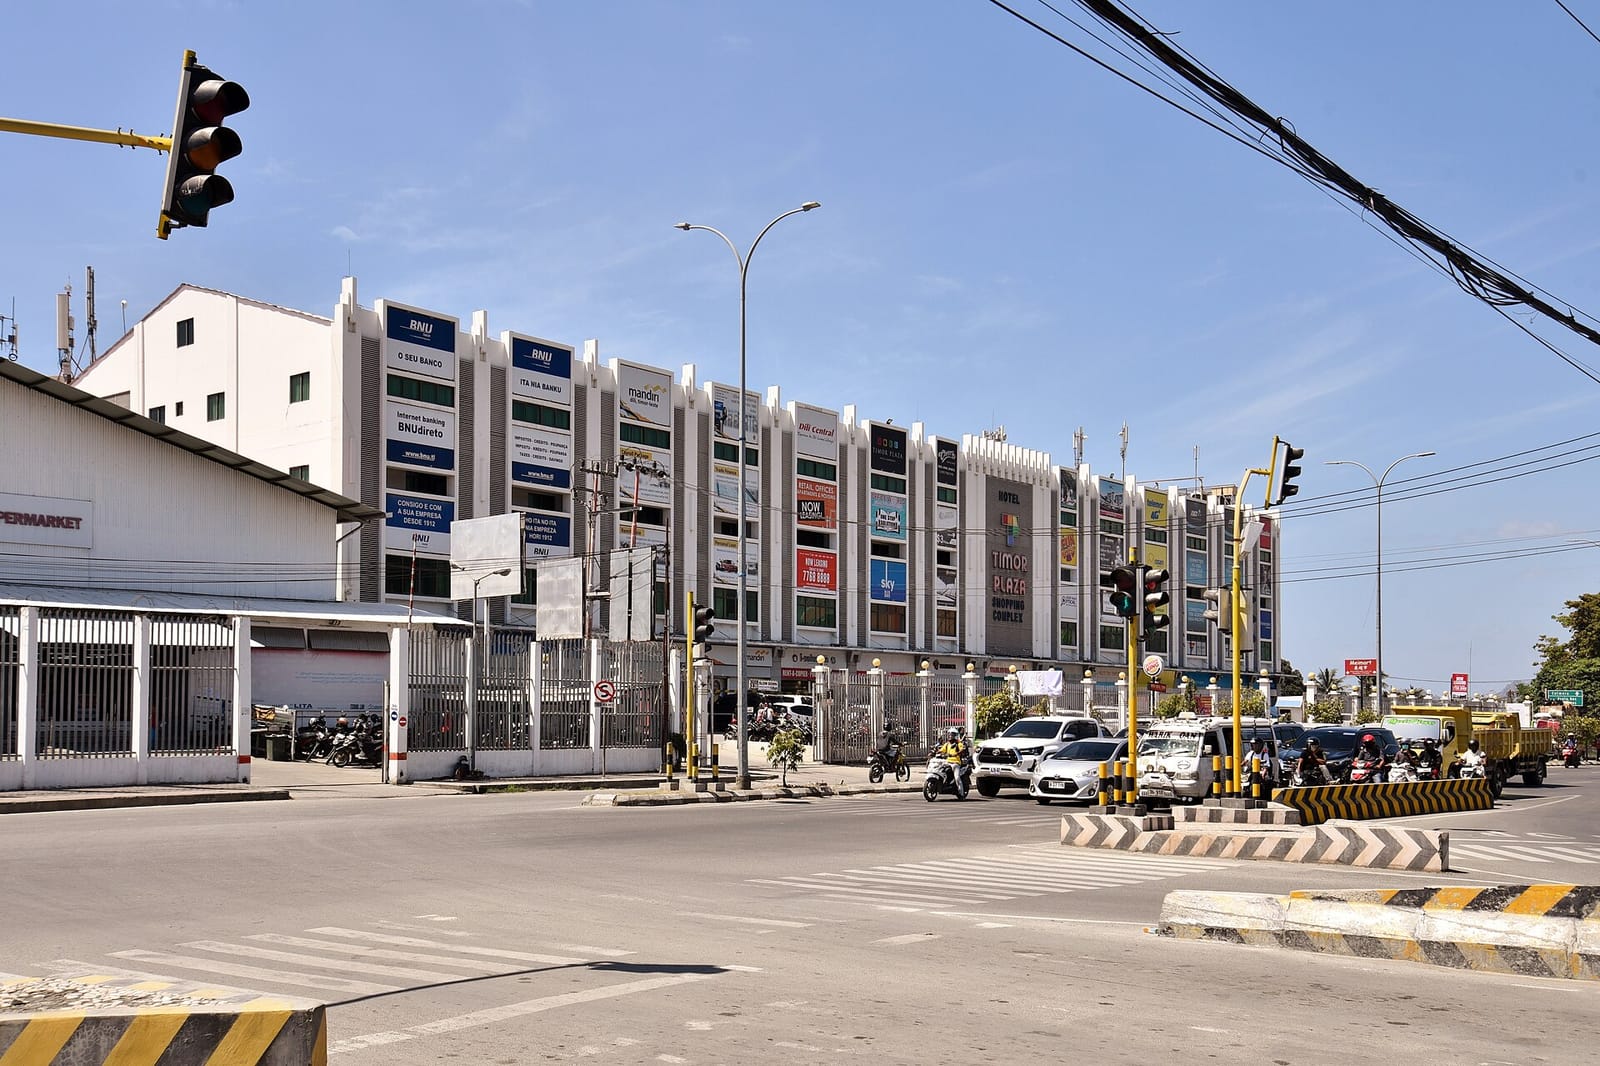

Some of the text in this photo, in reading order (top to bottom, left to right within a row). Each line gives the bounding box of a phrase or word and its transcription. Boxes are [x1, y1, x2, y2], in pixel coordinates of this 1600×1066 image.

[410, 319, 433, 334] BNU
[404, 353, 418, 362] SEU
[420, 356, 442, 368] BANCO
[532, 348, 552, 361] BNU
[520, 378, 562, 394] ITA NIA BANKU
[397, 411, 446, 428] Internet banking
[398, 422, 444, 438] BNUdireto
[799, 423, 834, 437] Dili Central
[872, 446, 903, 459] TIMOR PLAZA
[998, 490, 1020, 504] HOTEL
[398, 500, 423, 509] CONSIGO
[801, 501, 820, 511] NOW
[404, 517, 423, 525] DESDE
[416, 511, 442, 520] EMPRESA
[534, 548, 549, 556] BNU
[992, 551, 1028, 572] TIMOR
[881, 578, 895, 592] sky
[992, 576, 1026, 595] PLAZA
[992, 596, 1024, 611] SHOPPING
[992, 610, 1023, 623] COMPLEX
